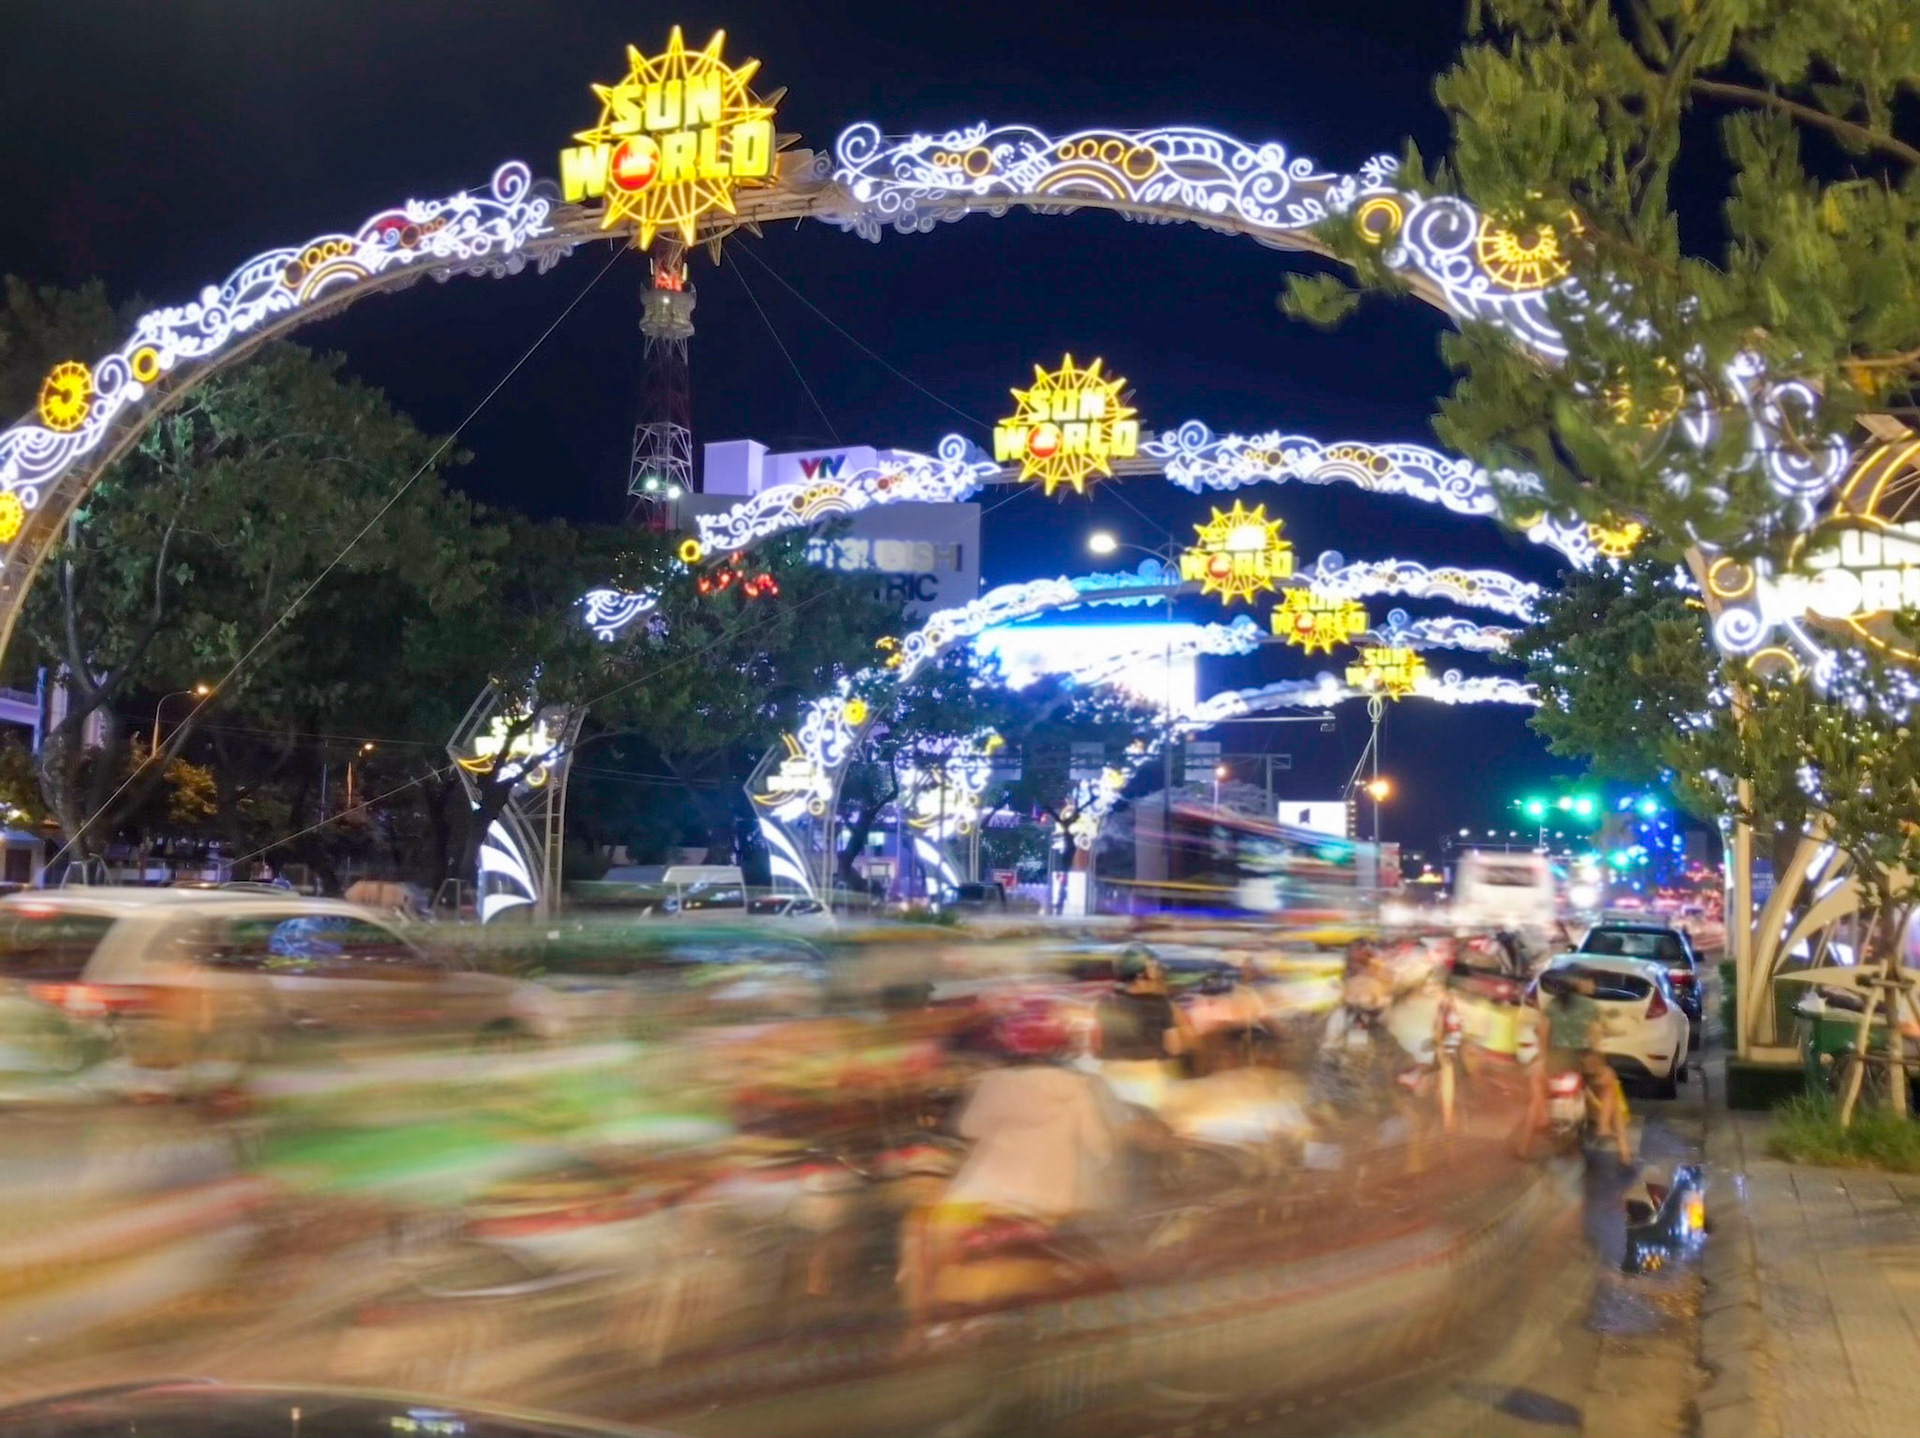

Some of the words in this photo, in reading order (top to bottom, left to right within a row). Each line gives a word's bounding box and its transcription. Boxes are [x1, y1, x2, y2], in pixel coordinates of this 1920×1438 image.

[611, 70, 723, 135] SUN
[560, 118, 773, 204] WORLD
[1026, 384, 1107, 422] SUN
[993, 419, 1140, 463] WORLD
[1180, 550, 1293, 581] WORLD
[1363, 647, 1408, 666] SUN
